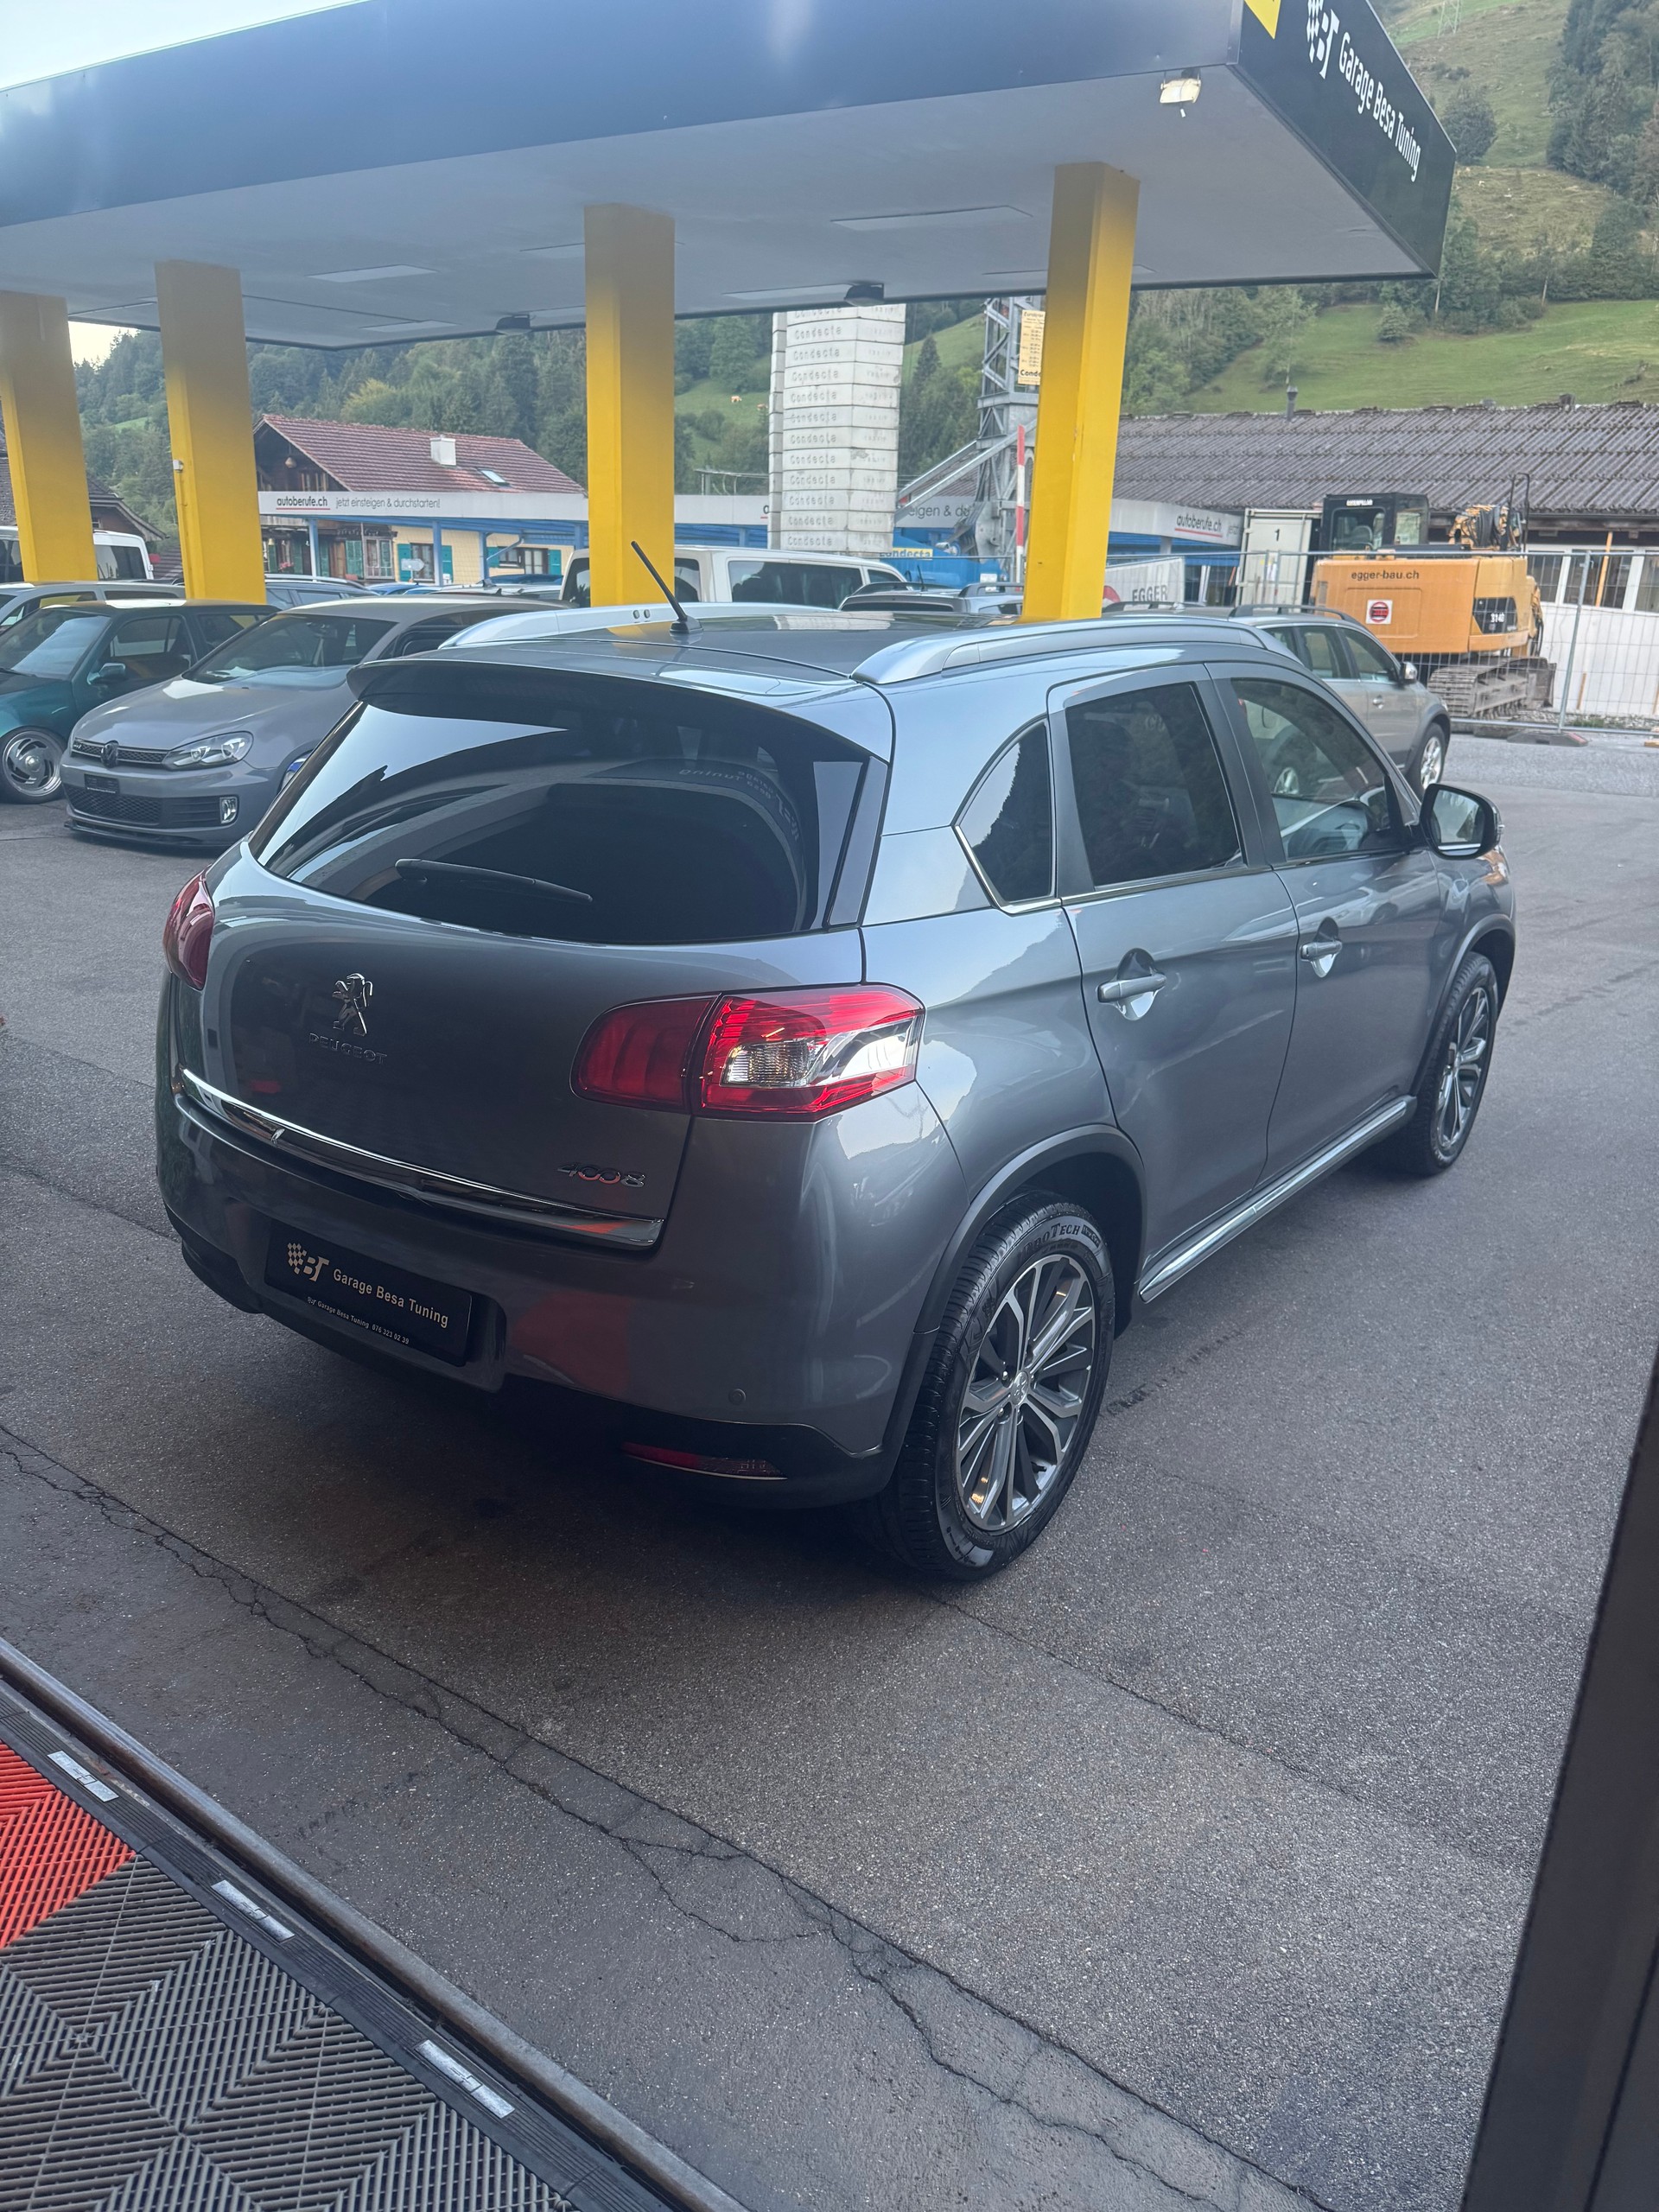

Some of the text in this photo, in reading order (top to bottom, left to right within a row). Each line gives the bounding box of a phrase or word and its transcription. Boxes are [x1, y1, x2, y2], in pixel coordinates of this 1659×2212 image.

[1338, 31, 1375, 114] Garage
[1372, 81, 1396, 139] Besa
[1395, 111, 1421, 182] Tuning
[793, 347, 841, 361] Condecta
[791, 369, 839, 382] Condecta
[790, 391, 837, 404] Condecta
[790, 432, 837, 444] Condecta
[790, 453, 836, 465] Condecta
[790, 474, 836, 486] Condecta
[276, 496, 328, 506] autoberufe.ch
[335, 498, 441, 509] jetzt einsteigen & durchstarten!
[908, 505, 940, 519] eigen
[944, 505, 952, 517] &
[1176, 513, 1222, 531] autoberufe.ch
[1274, 529, 1281, 542] 1
[1351, 569, 1420, 581] egger-bau.ch
[1132, 584, 1168, 601] EGGER
[308, 1033, 387, 1065] PEUGEOT
[556, 1164, 646, 1188] 4008
[333, 1268, 372, 1294] Garage
[376, 1285, 404, 1308] Besa
[409, 1298, 449, 1329] Tuning
[317, 1300, 336, 1314] Garage
[336, 1308, 349, 1319] Besa
[350, 1314, 370, 1329] Tuning
[372, 1324, 382, 1334] 076
[382, 1328, 393, 1338] 323
[401, 1336, 410, 1344] 39
